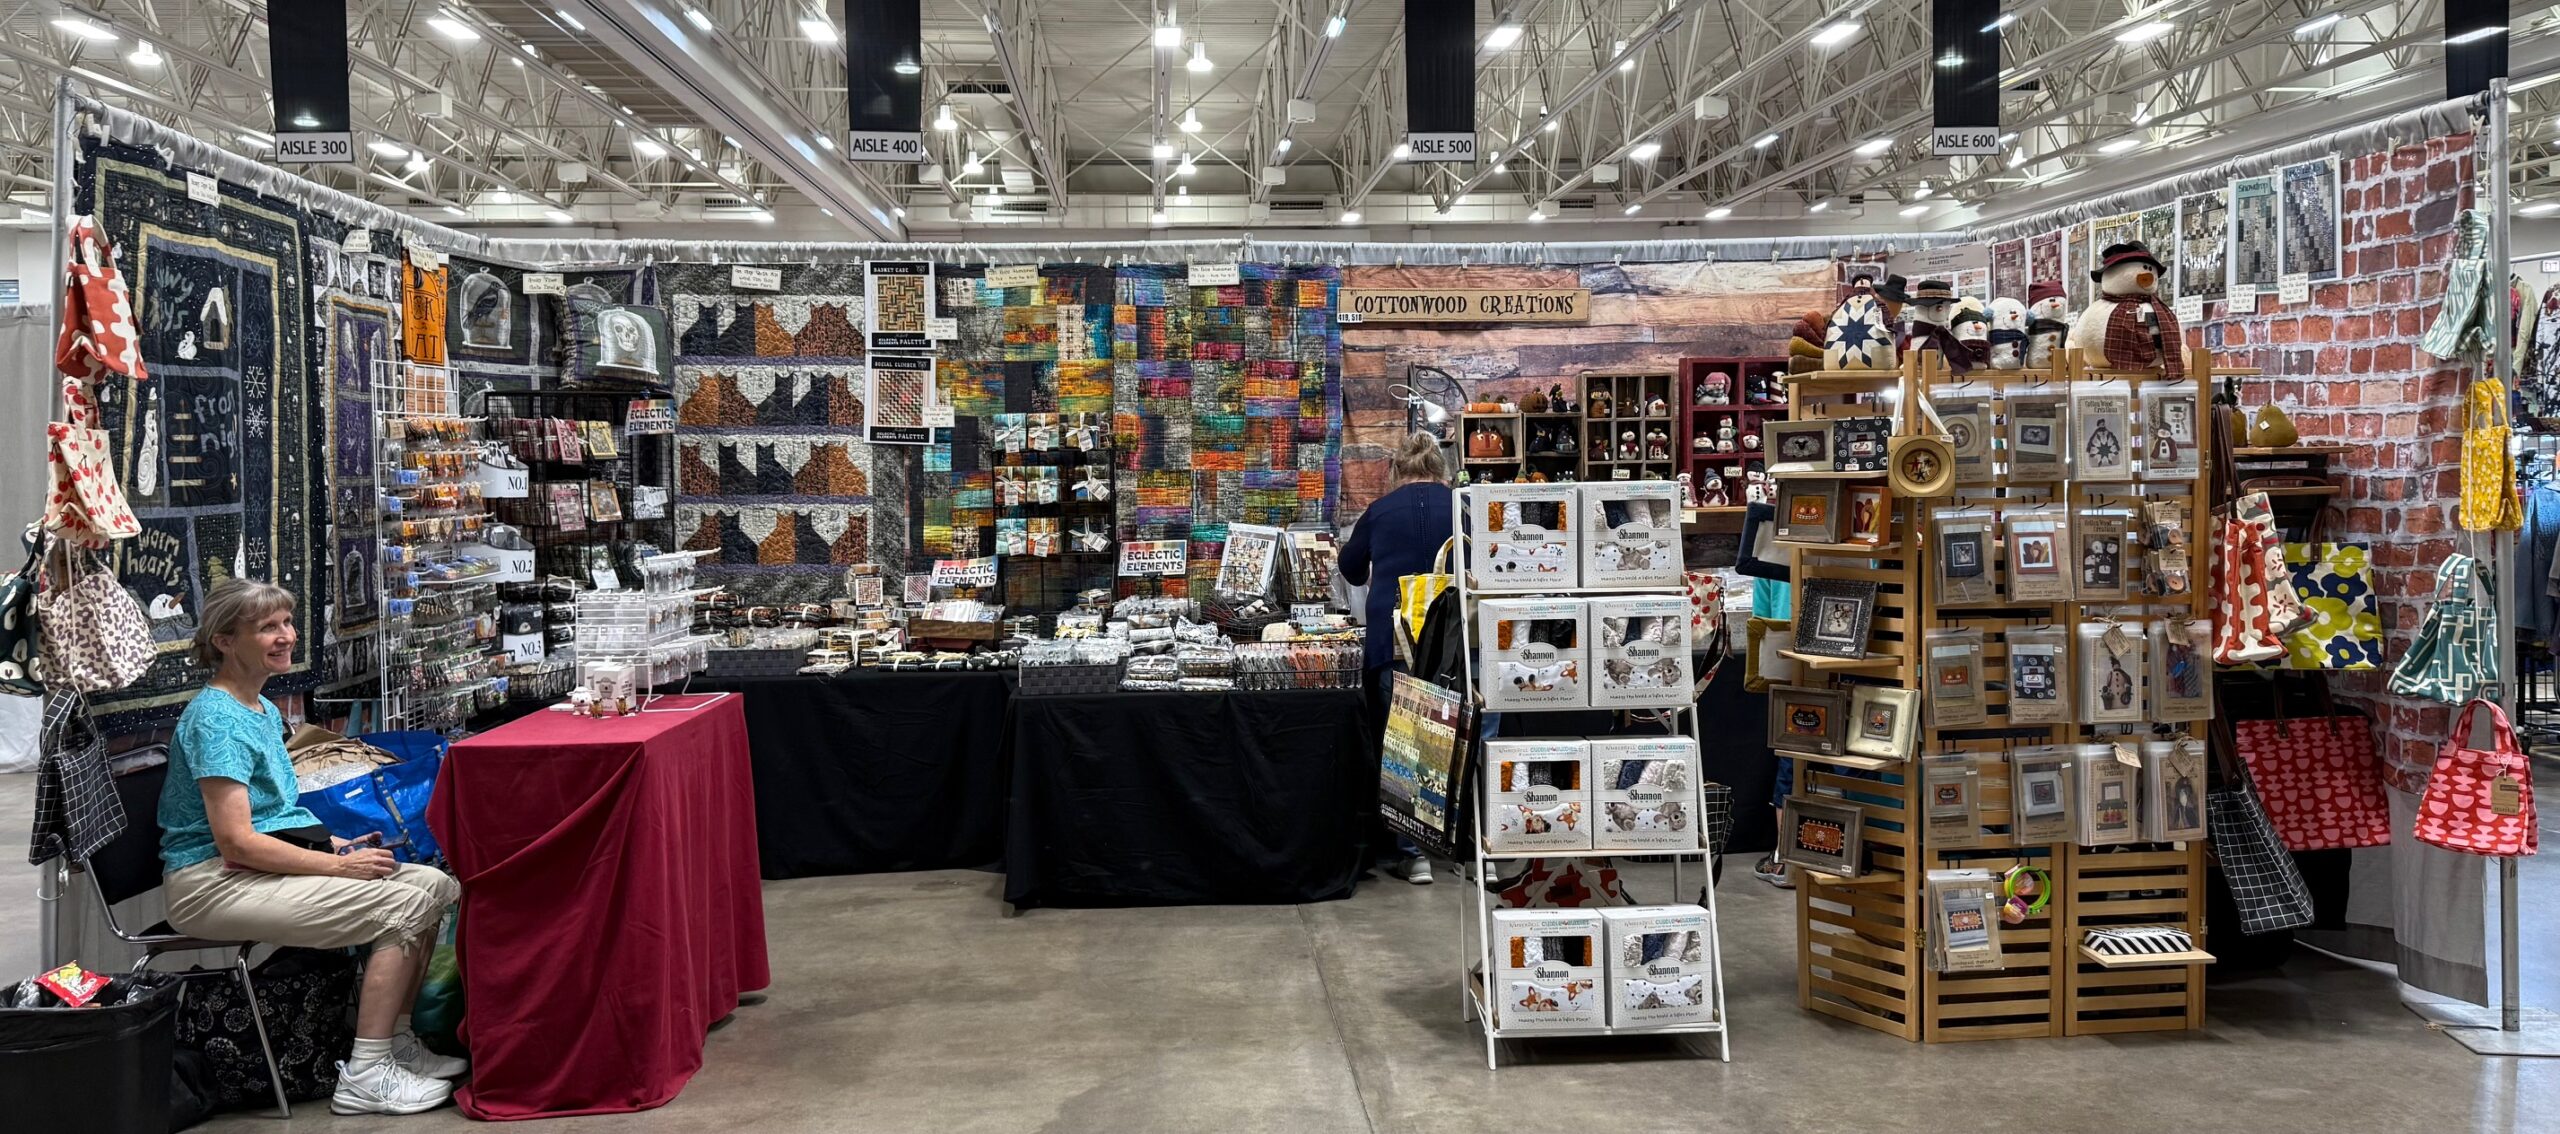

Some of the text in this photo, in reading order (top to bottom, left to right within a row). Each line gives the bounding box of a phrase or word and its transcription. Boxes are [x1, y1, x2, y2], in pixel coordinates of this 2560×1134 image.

[852, 138, 918, 154] AISLE 400
[1411, 139, 1472, 153] AISLE 500
[1936, 134, 1996, 148] AISLE 600
[279, 140, 347, 155] AISLE 300
[1354, 293, 1574, 316] COTTONWOOD CREATIONS
[630, 408, 671, 420] ECLECTIC
[629, 420, 674, 432] ELEMENTS
[1613, 470, 1629, 479] New
[1725, 467, 1741, 476] New
[507, 476, 528, 490] NO.1
[1513, 530, 1544, 541] Shannon
[1618, 529, 1650, 540] Shannon
[137, 527, 180, 556] warm
[1127, 549, 1181, 561] ECLECTIC
[126, 546, 183, 587] hearts
[511, 560, 533, 574] NO.2
[939, 563, 995, 575] ECLECTIC
[1126, 560, 1183, 572] ELEMENTS
[937, 574, 996, 585] ELEMENTS
[1293, 607, 1324, 620] SALE
[520, 640, 542, 657] NO.3
[1522, 649, 1555, 660] Shannon
[1627, 645, 1660, 657] Shannon
[1525, 791, 1558, 802] Shannon
[1629, 789, 1662, 800] Shannon
[1398, 812, 1425, 836] PALETTE
[1536, 966, 1569, 978] Shannon
[1648, 964, 1680, 976] Shannon
